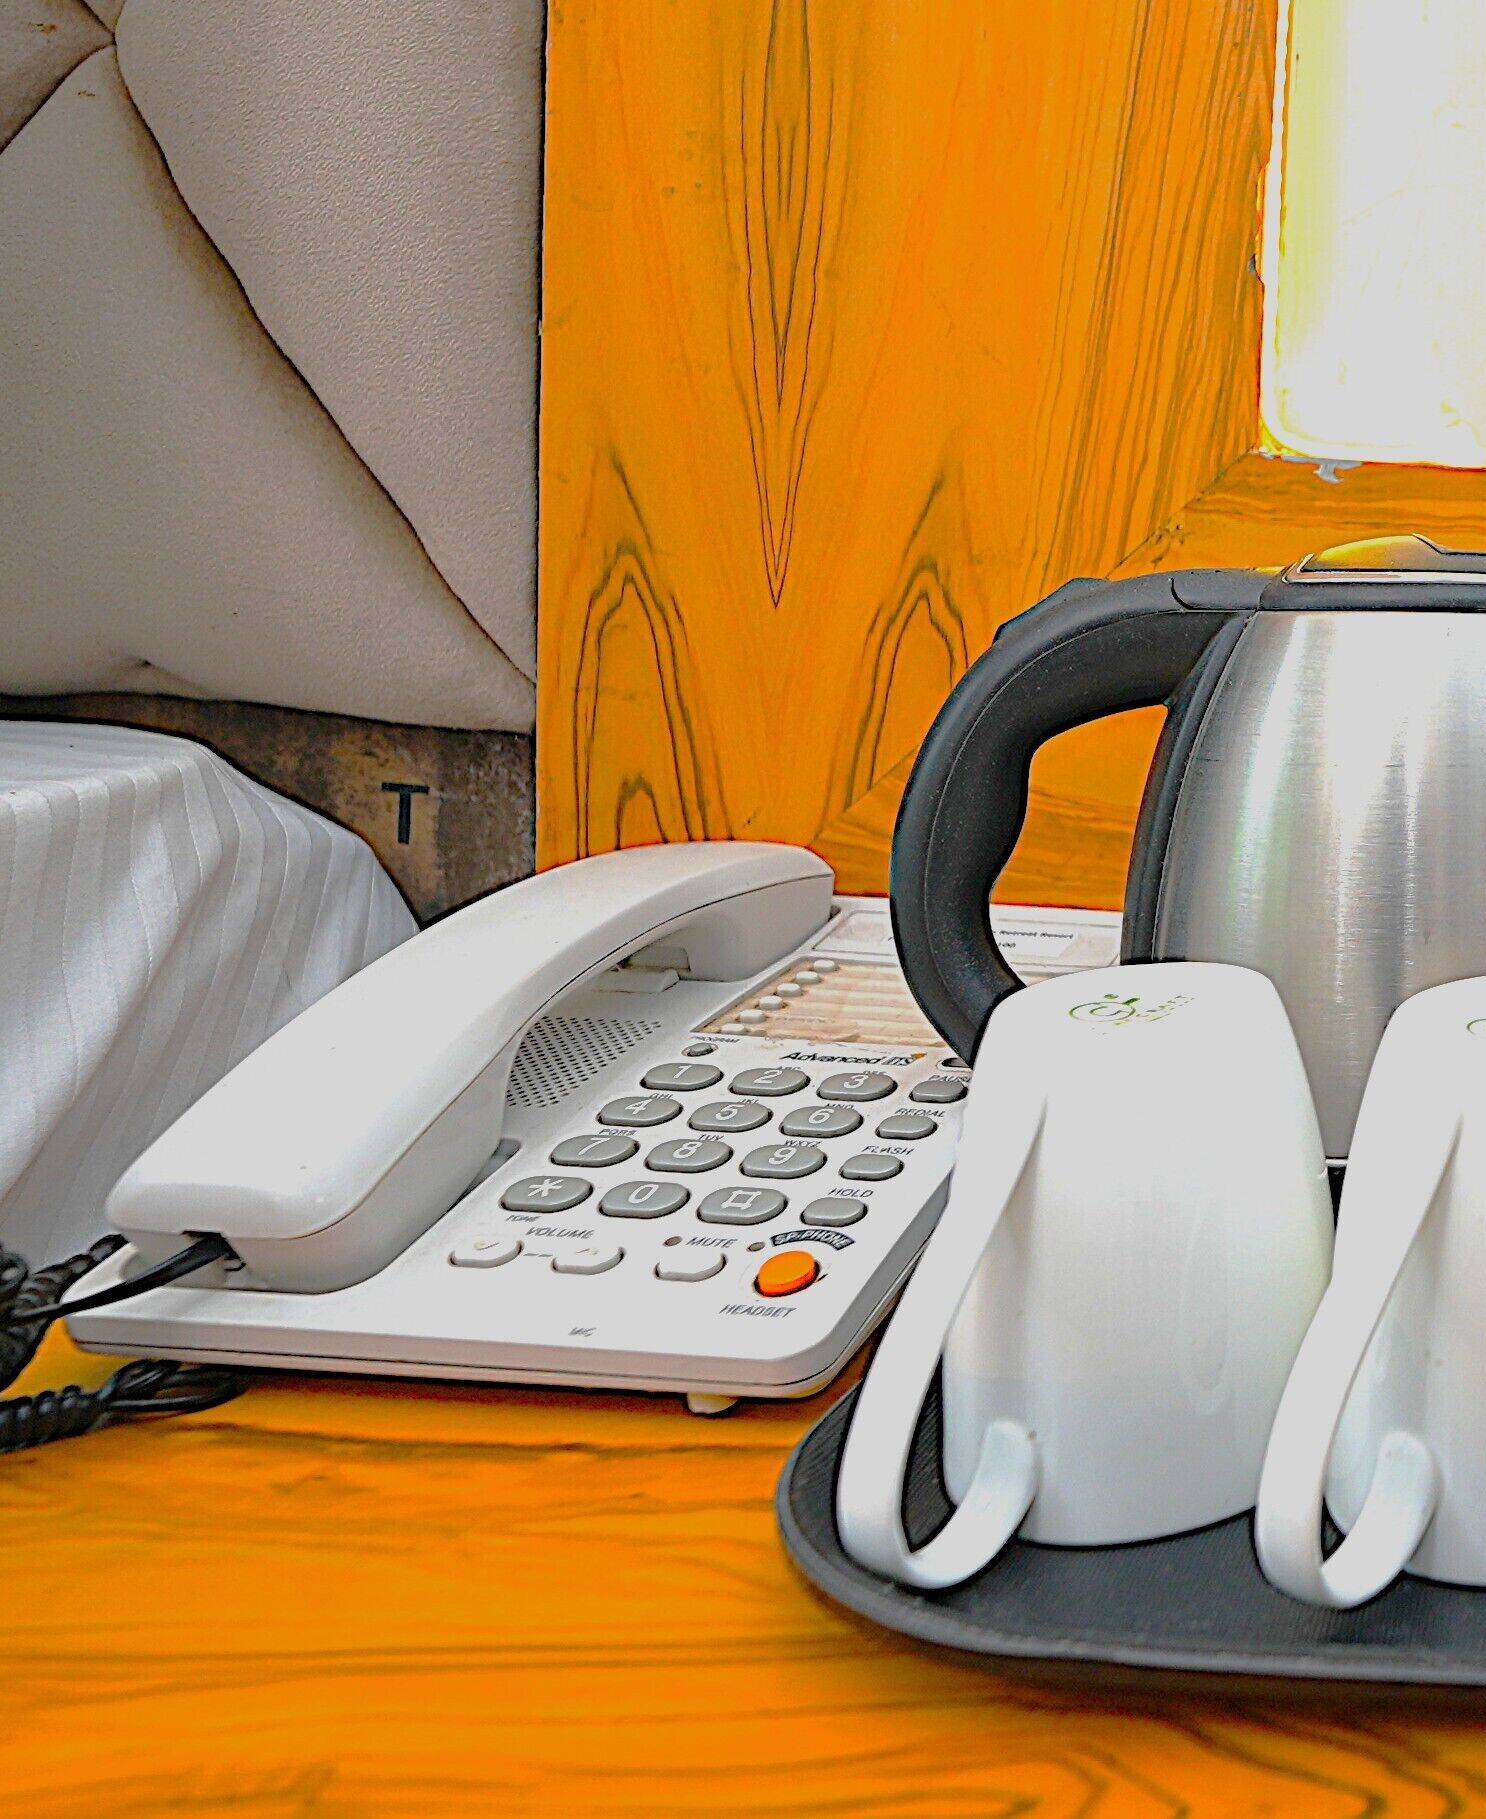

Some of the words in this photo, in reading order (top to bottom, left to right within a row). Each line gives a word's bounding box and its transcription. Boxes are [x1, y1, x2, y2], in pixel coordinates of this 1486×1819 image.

[381, 782, 429, 844] T
[780, 1052, 882, 1065] Advanced
[673, 1065, 692, 1079] 1
[754, 1070, 782, 1083] 2
[844, 1074, 868, 1088] 3
[625, 1099, 652, 1114] 4
[715, 1104, 745, 1120] 5
[895, 1108, 945, 1117] REDIAL
[809, 1109, 834, 1124] 6
[579, 1137, 611, 1156] 7
[673, 1141, 702, 1158] 8
[783, 1140, 822, 1148] WXYZ
[862, 1146, 915, 1155] FLASH
[768, 1147, 797, 1164] 9
[828, 1188, 874, 1198] HOLD
[525, 1227, 595, 1239] VOLUME
[686, 1237, 738, 1248] MUTE
[719, 1304, 797, 1318] HEADSET
